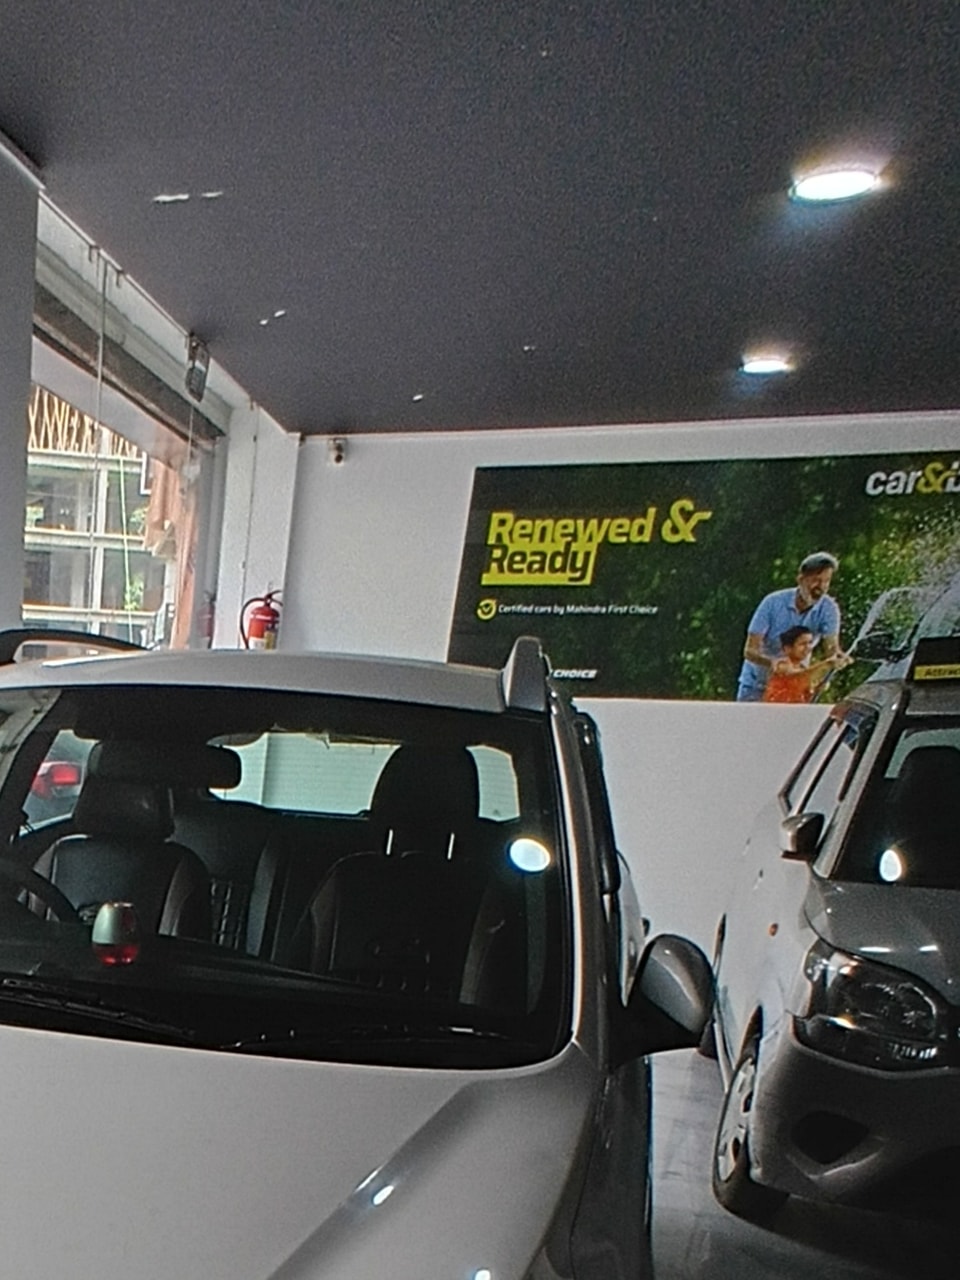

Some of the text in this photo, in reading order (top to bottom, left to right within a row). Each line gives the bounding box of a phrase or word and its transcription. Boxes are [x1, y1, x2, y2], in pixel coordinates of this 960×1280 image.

[487, 499, 712, 545] Renewed &
[488, 545, 591, 582] Ready
[498, 604, 658, 616] Certified cars by Mahindra First Choice
[553, 669, 598, 679] CHOICE
